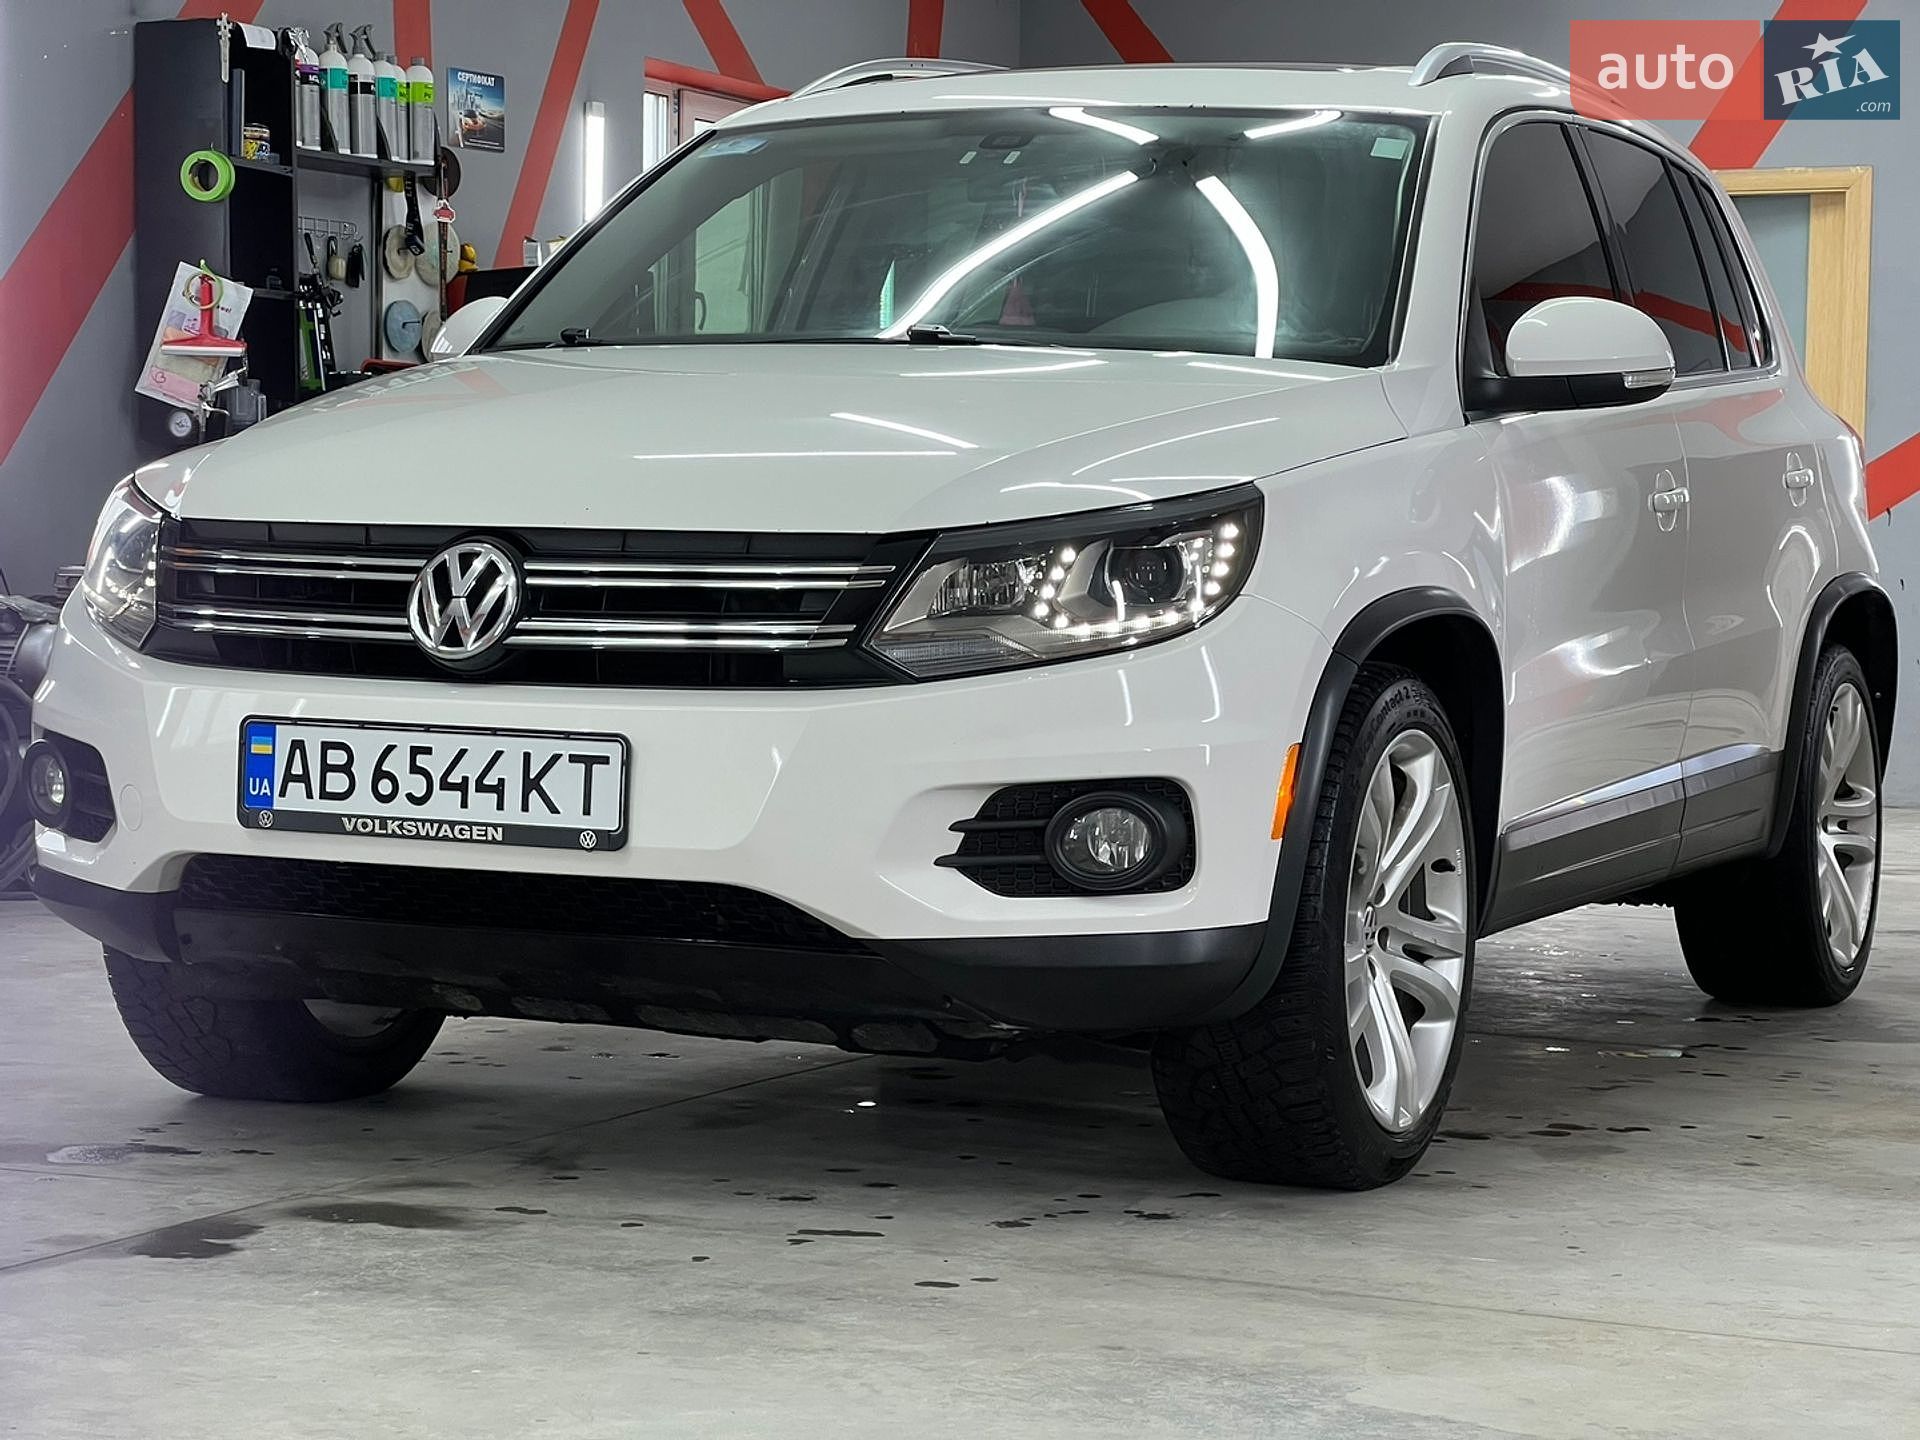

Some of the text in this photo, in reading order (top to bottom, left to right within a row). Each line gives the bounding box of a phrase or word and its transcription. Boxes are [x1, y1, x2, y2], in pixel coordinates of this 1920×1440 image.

[249, 776, 271, 796] UA
[278, 738, 611, 816] AB 6544 KT
[341, 816, 503, 842] VOLKSWAGEN
